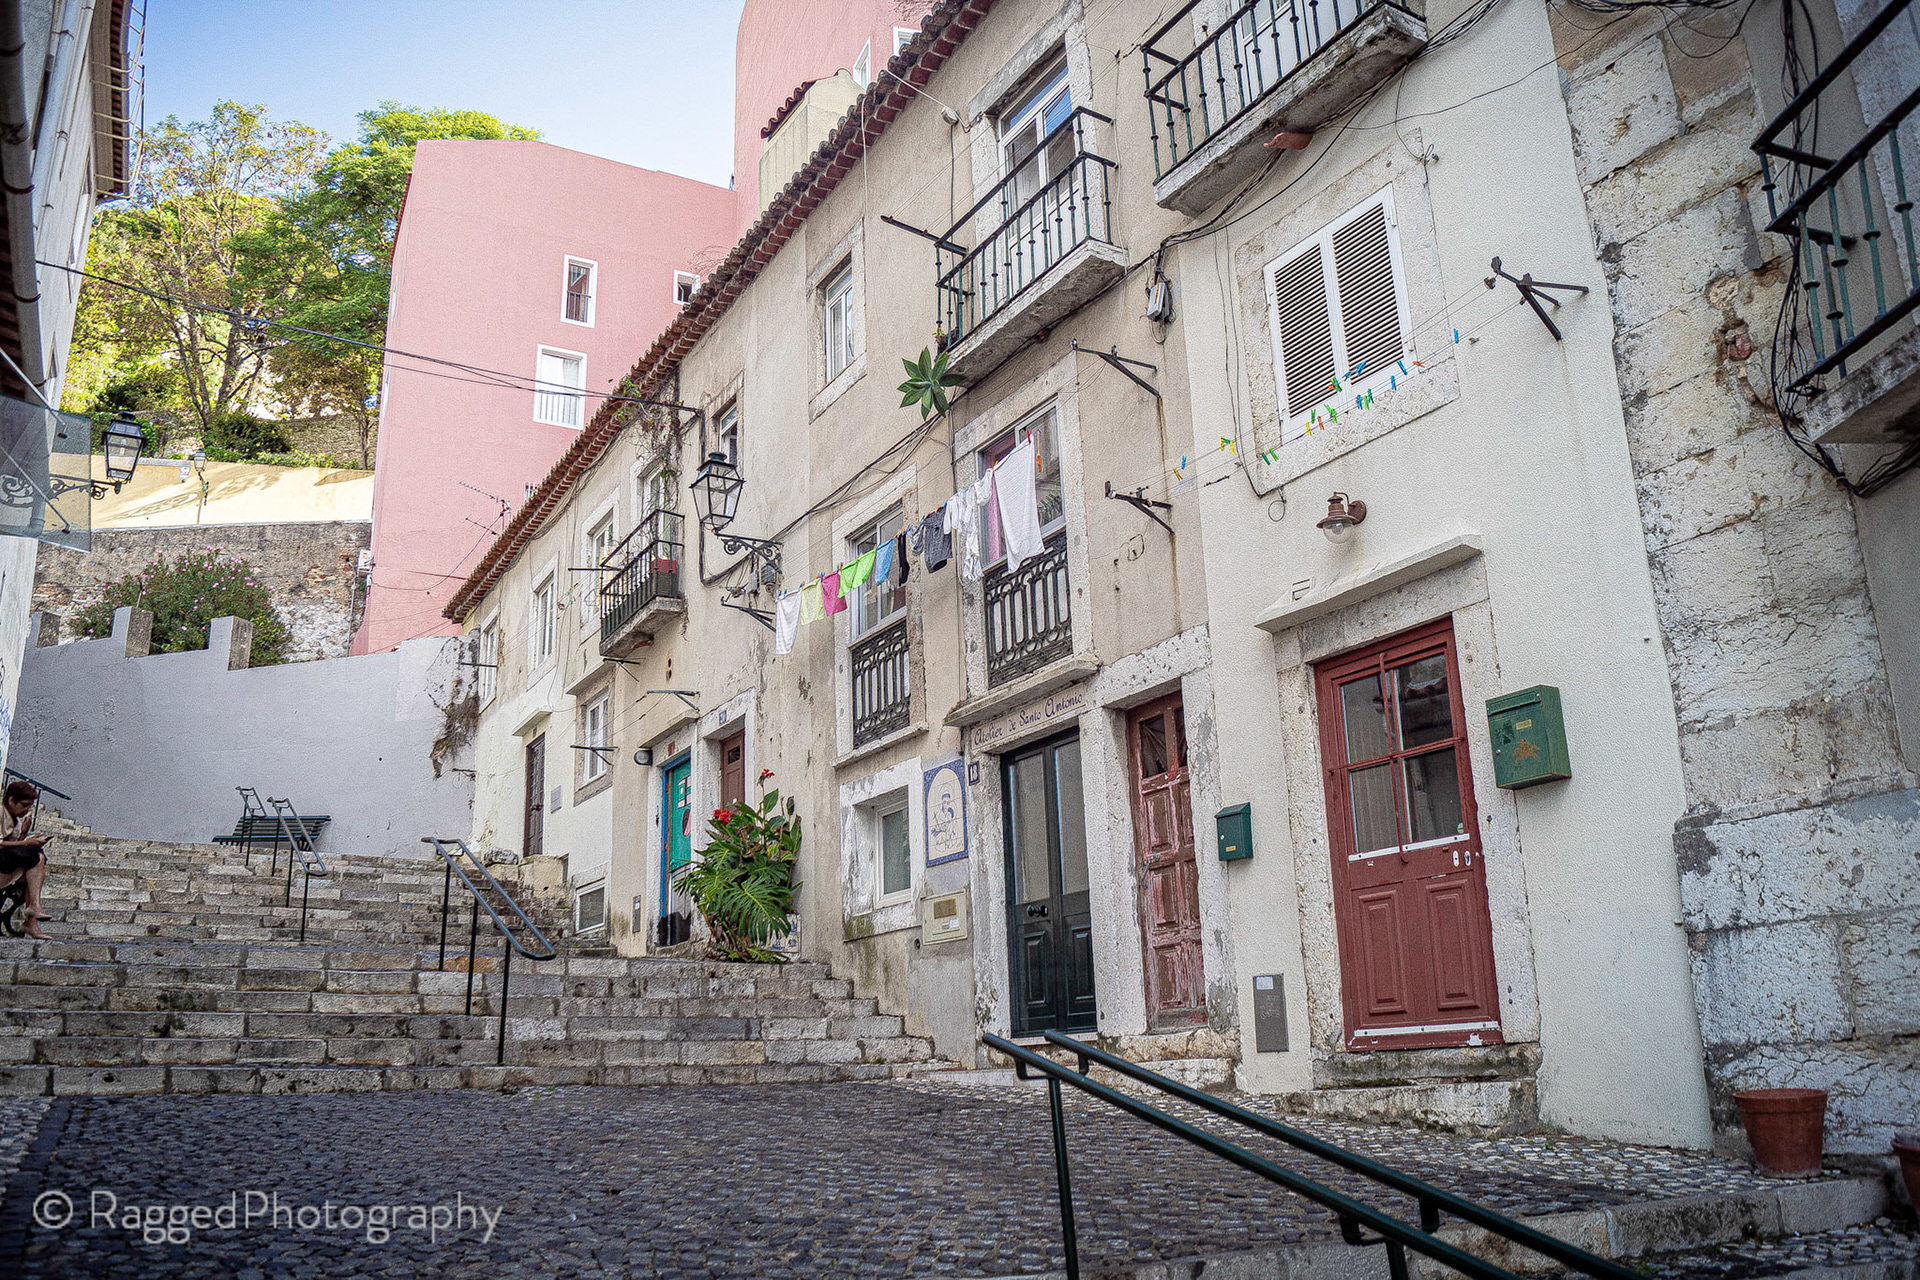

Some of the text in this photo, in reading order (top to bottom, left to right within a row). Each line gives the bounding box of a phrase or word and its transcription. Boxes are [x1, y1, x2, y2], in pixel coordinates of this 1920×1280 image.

[974, 692, 1083, 746] Atelier de Santo António
